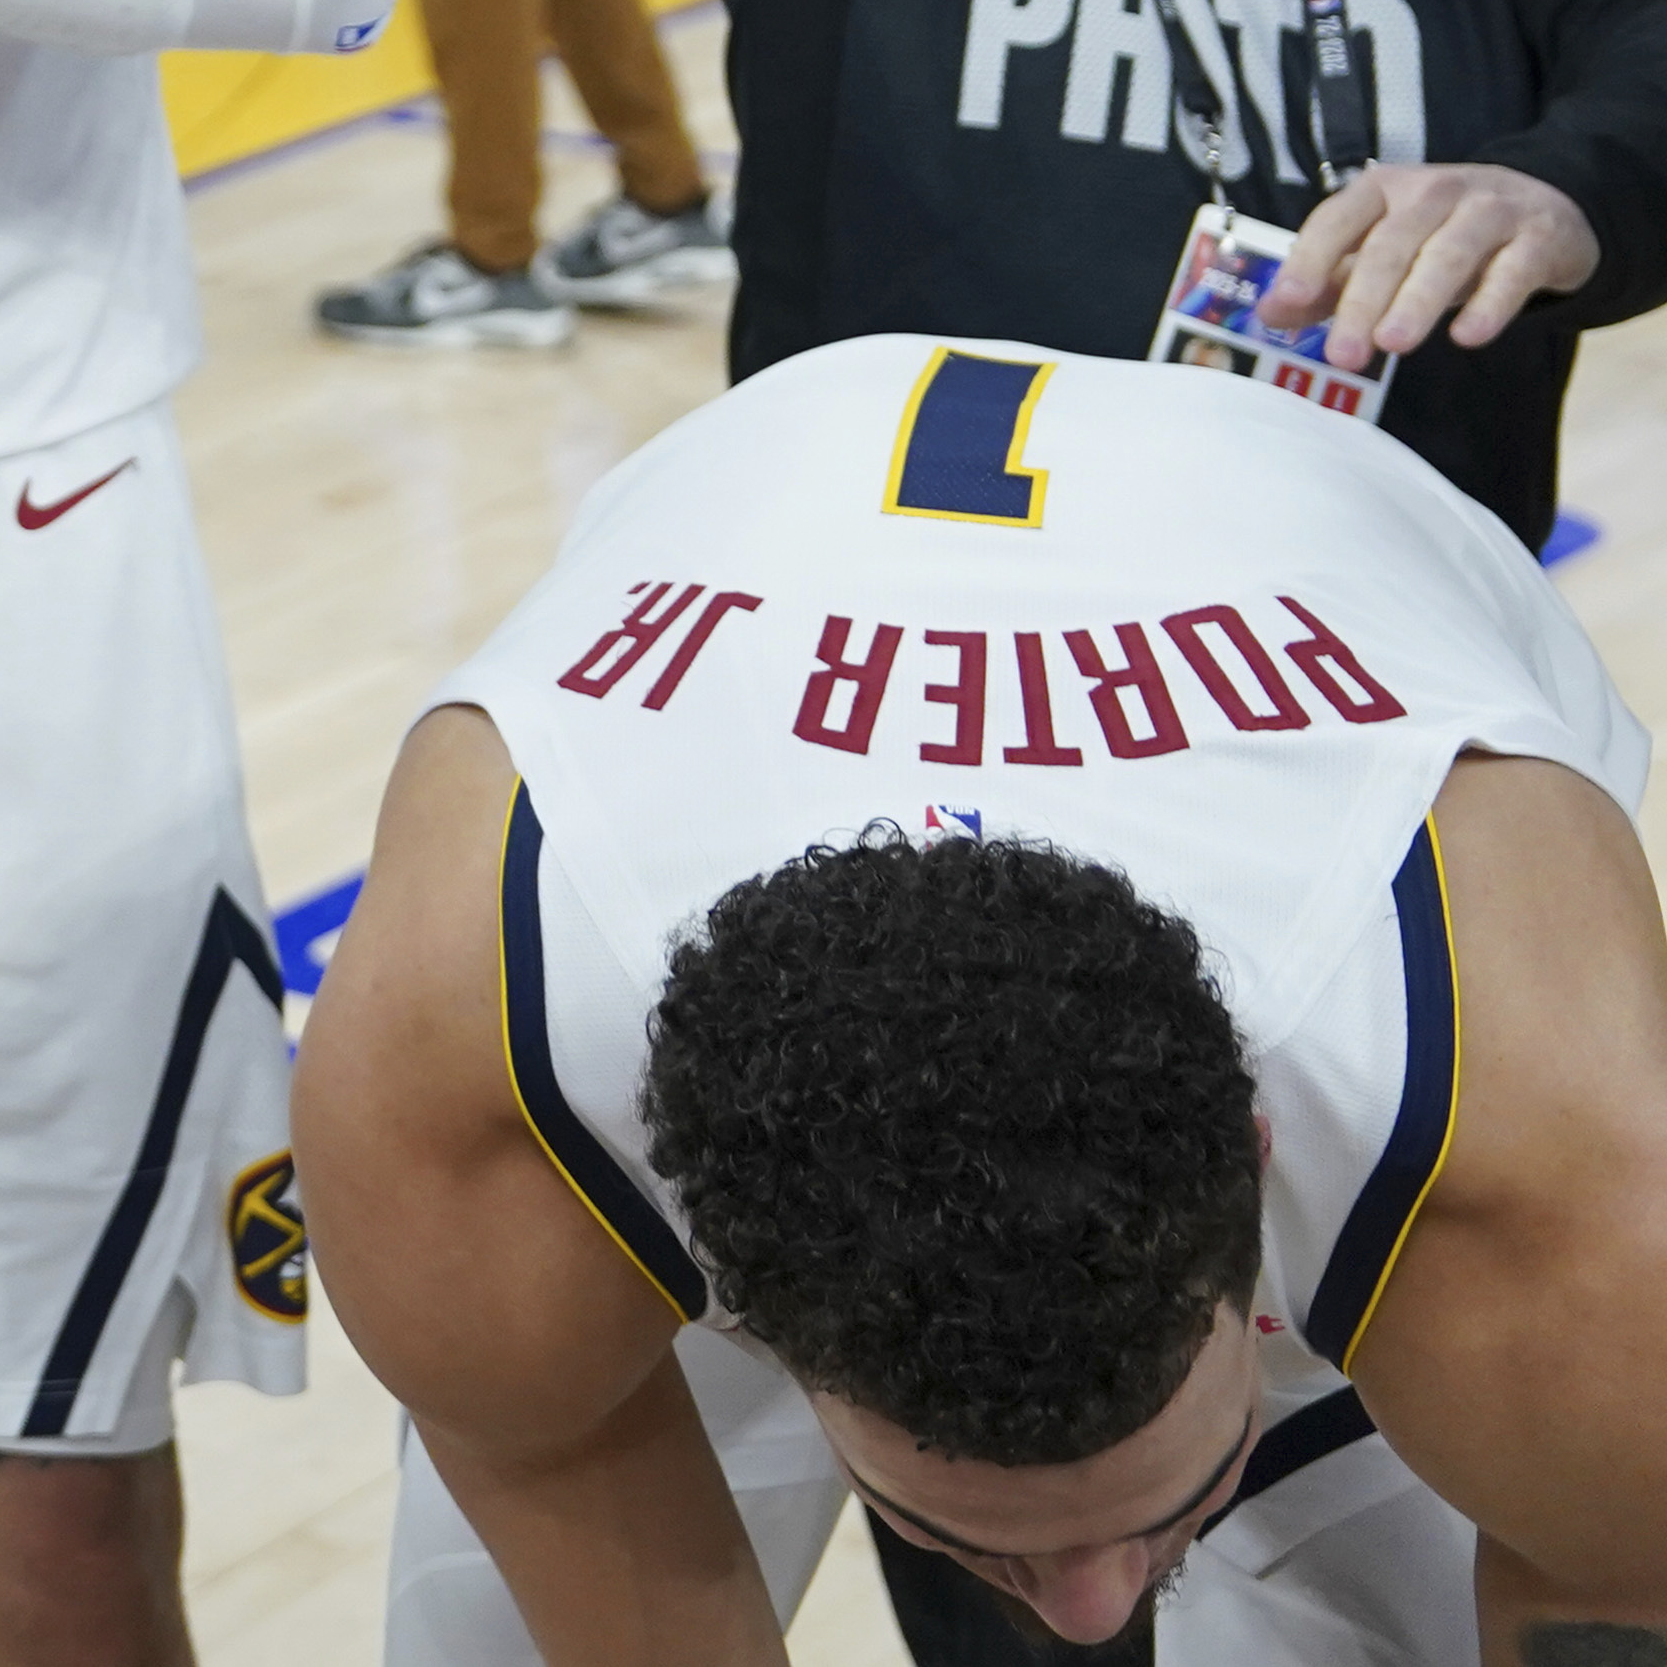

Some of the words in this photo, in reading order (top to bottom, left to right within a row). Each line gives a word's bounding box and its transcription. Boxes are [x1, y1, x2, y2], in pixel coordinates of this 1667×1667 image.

[881, 345, 1058, 530] 1
[556, 580, 764, 711] JR.
[792, 594, 1408, 768] PORTER
